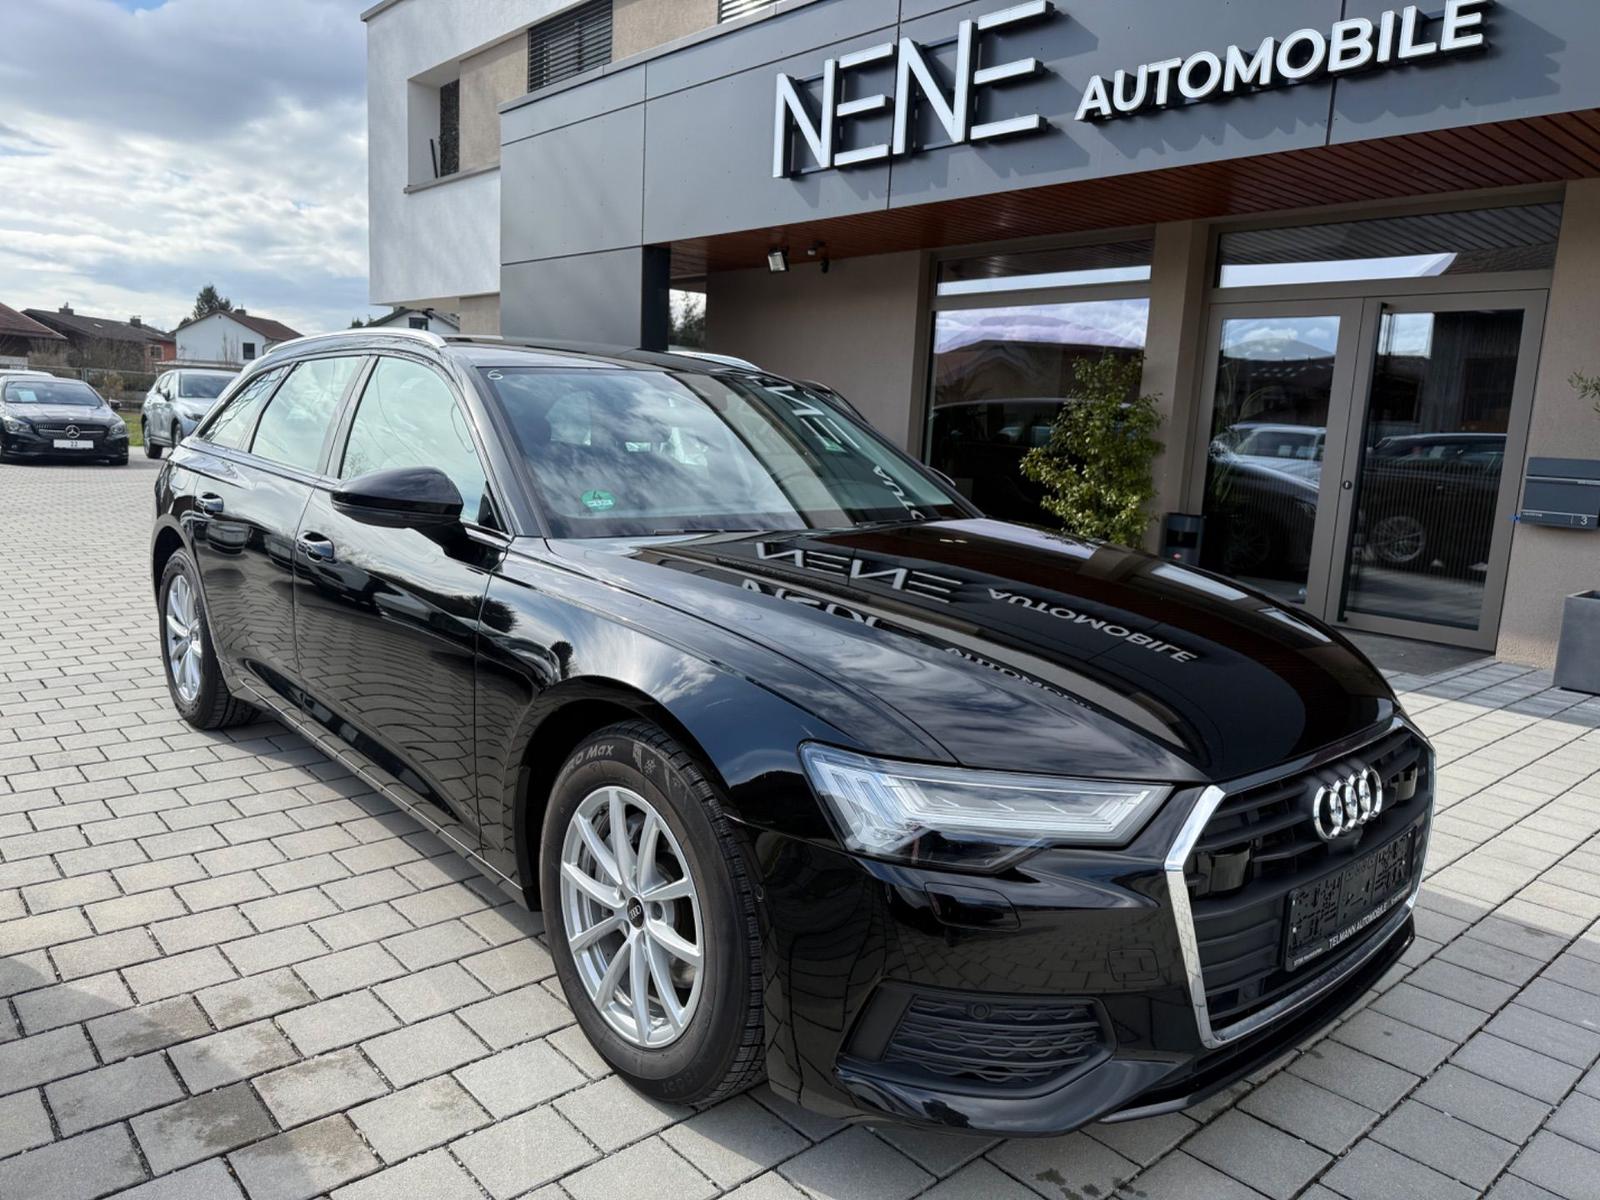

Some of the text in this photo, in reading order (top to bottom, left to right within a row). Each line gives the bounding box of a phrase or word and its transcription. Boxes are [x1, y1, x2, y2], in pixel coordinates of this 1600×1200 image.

[773, 0, 1487, 178] NENE AUTOMOBILE
[1580, 514, 1588, 526] 3
